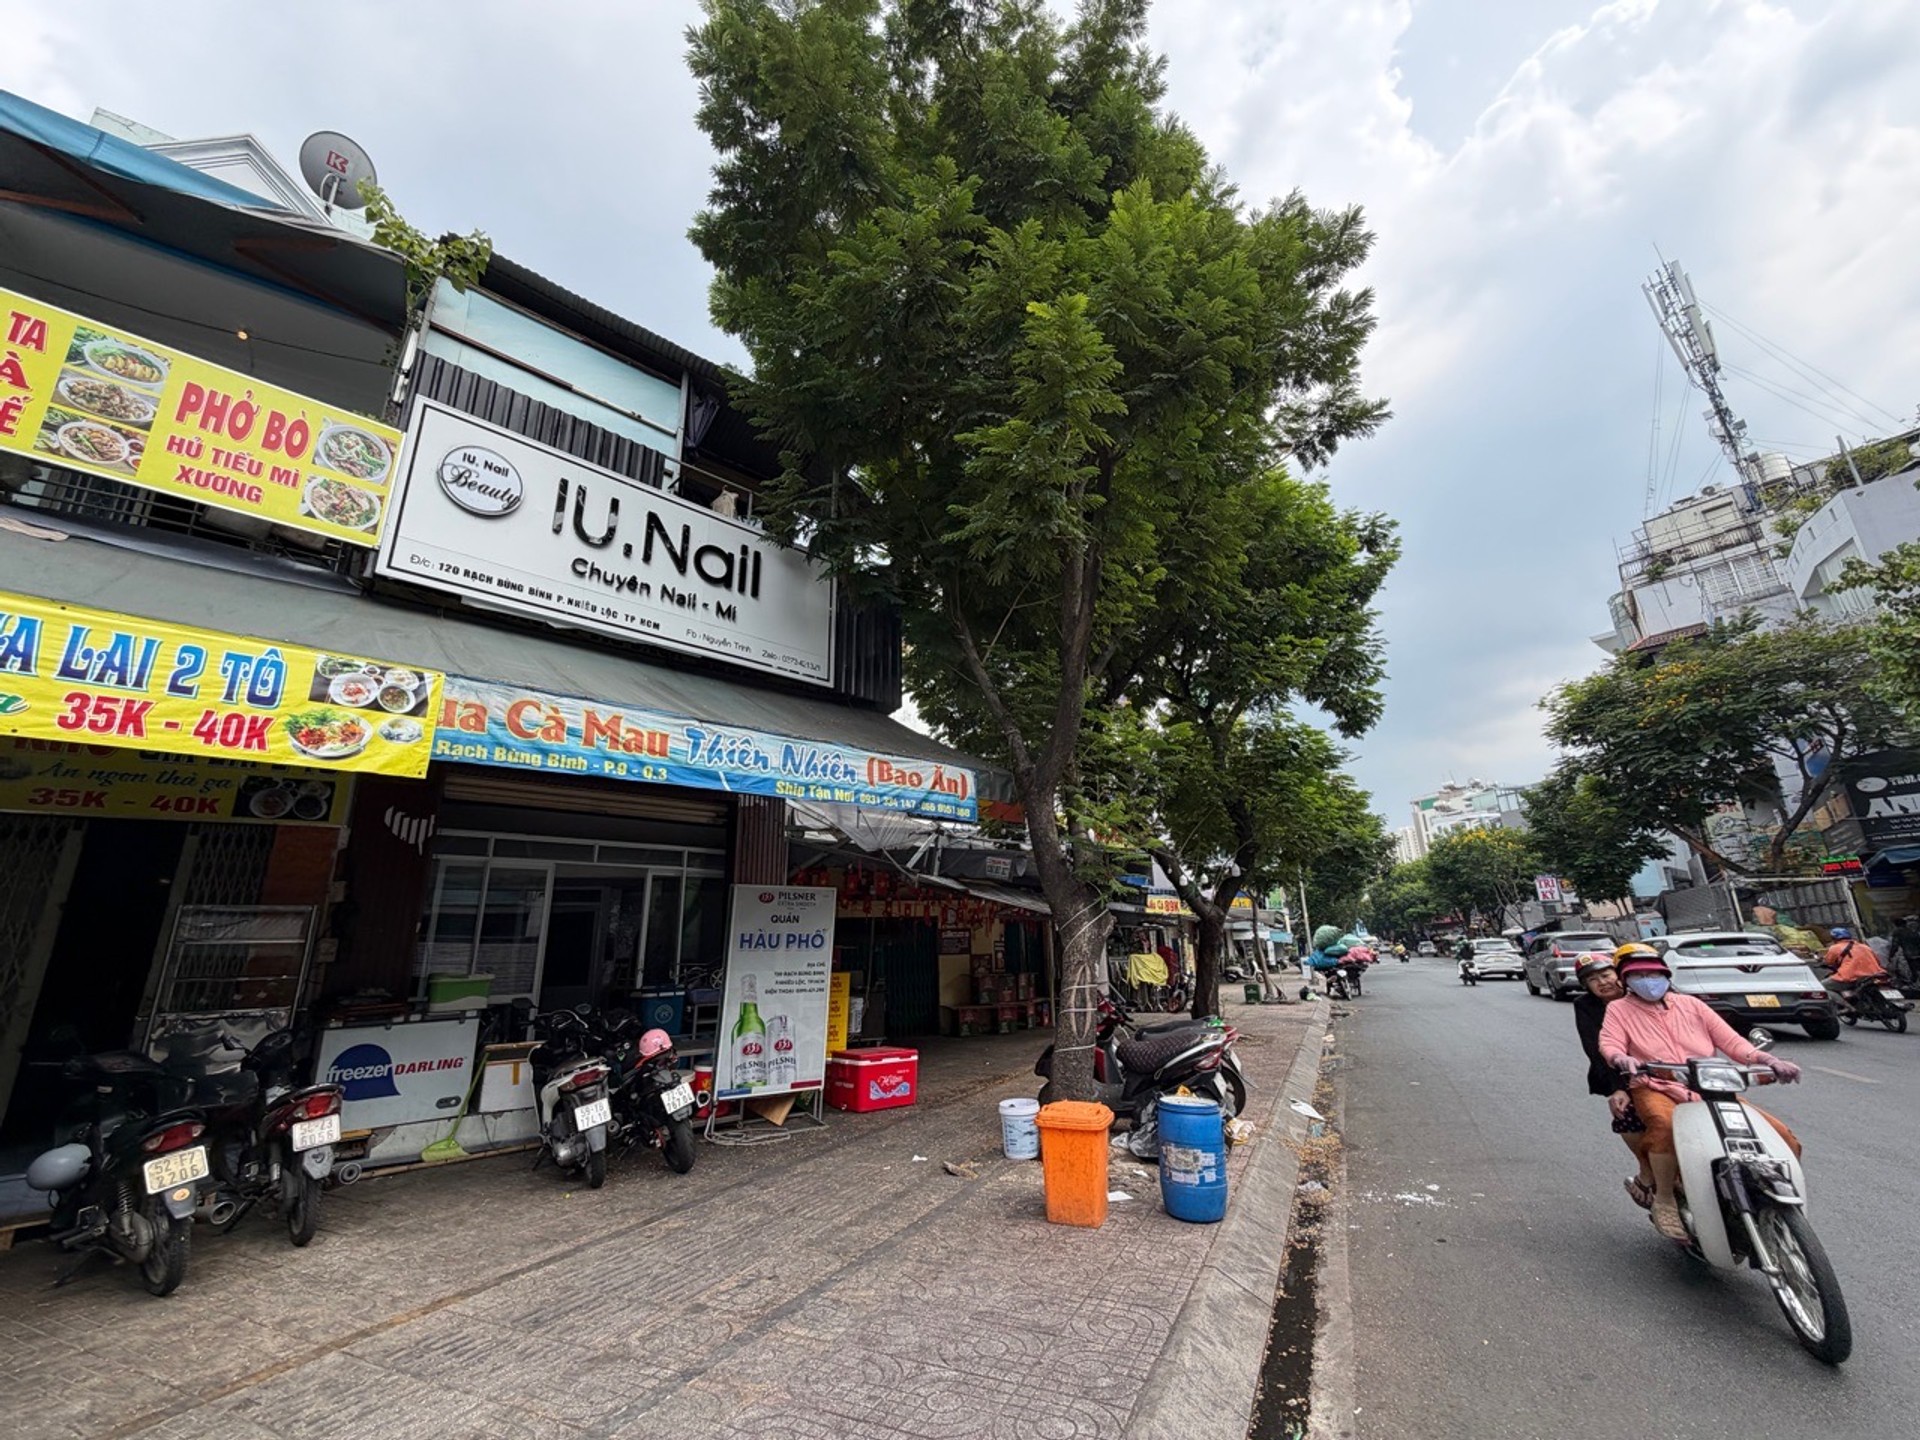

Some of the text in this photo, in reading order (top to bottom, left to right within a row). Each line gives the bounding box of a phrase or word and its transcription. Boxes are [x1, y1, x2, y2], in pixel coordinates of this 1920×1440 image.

[7, 310, 48, 353] TA
[175, 381, 310, 460] PHỞ BÒ
[483, 460, 510, 477] Nail
[174, 464, 264, 504] XƯƠNG
[442, 463, 521, 510] Beauty
[438, 561, 461, 576] 120
[463, 568, 494, 585] RẠCH
[624, 613, 637, 624] TP
[571, 557, 651, 597] Chuyên
[660, 583, 697, 611] Nail
[54, 623, 162, 693] LAI
[167, 644, 206, 699] 2
[219, 647, 288, 709] TÔ
[57, 691, 155, 739] 35K
[193, 709, 276, 752] 40K
[435, 739, 488, 761] Rạch
[506, 698, 567, 745] Cà
[581, 708, 670, 759] Mau
[683, 726, 771, 773] Thiên
[780, 743, 858, 785] Nhiên
[87, 768, 151, 787] ngon
[199, 776, 232, 794] ga
[775, 779, 806, 798] Ship
[28, 787, 108, 810] 35K
[149, 795, 220, 816] 40K
[778, 891, 816, 901] PILSNER
[770, 912, 800, 924] QUÁN
[739, 928, 781, 949] HÀU
[328, 1056, 464, 1083] freezer DARLING
[156, 1164, 200, 1189] 2206
